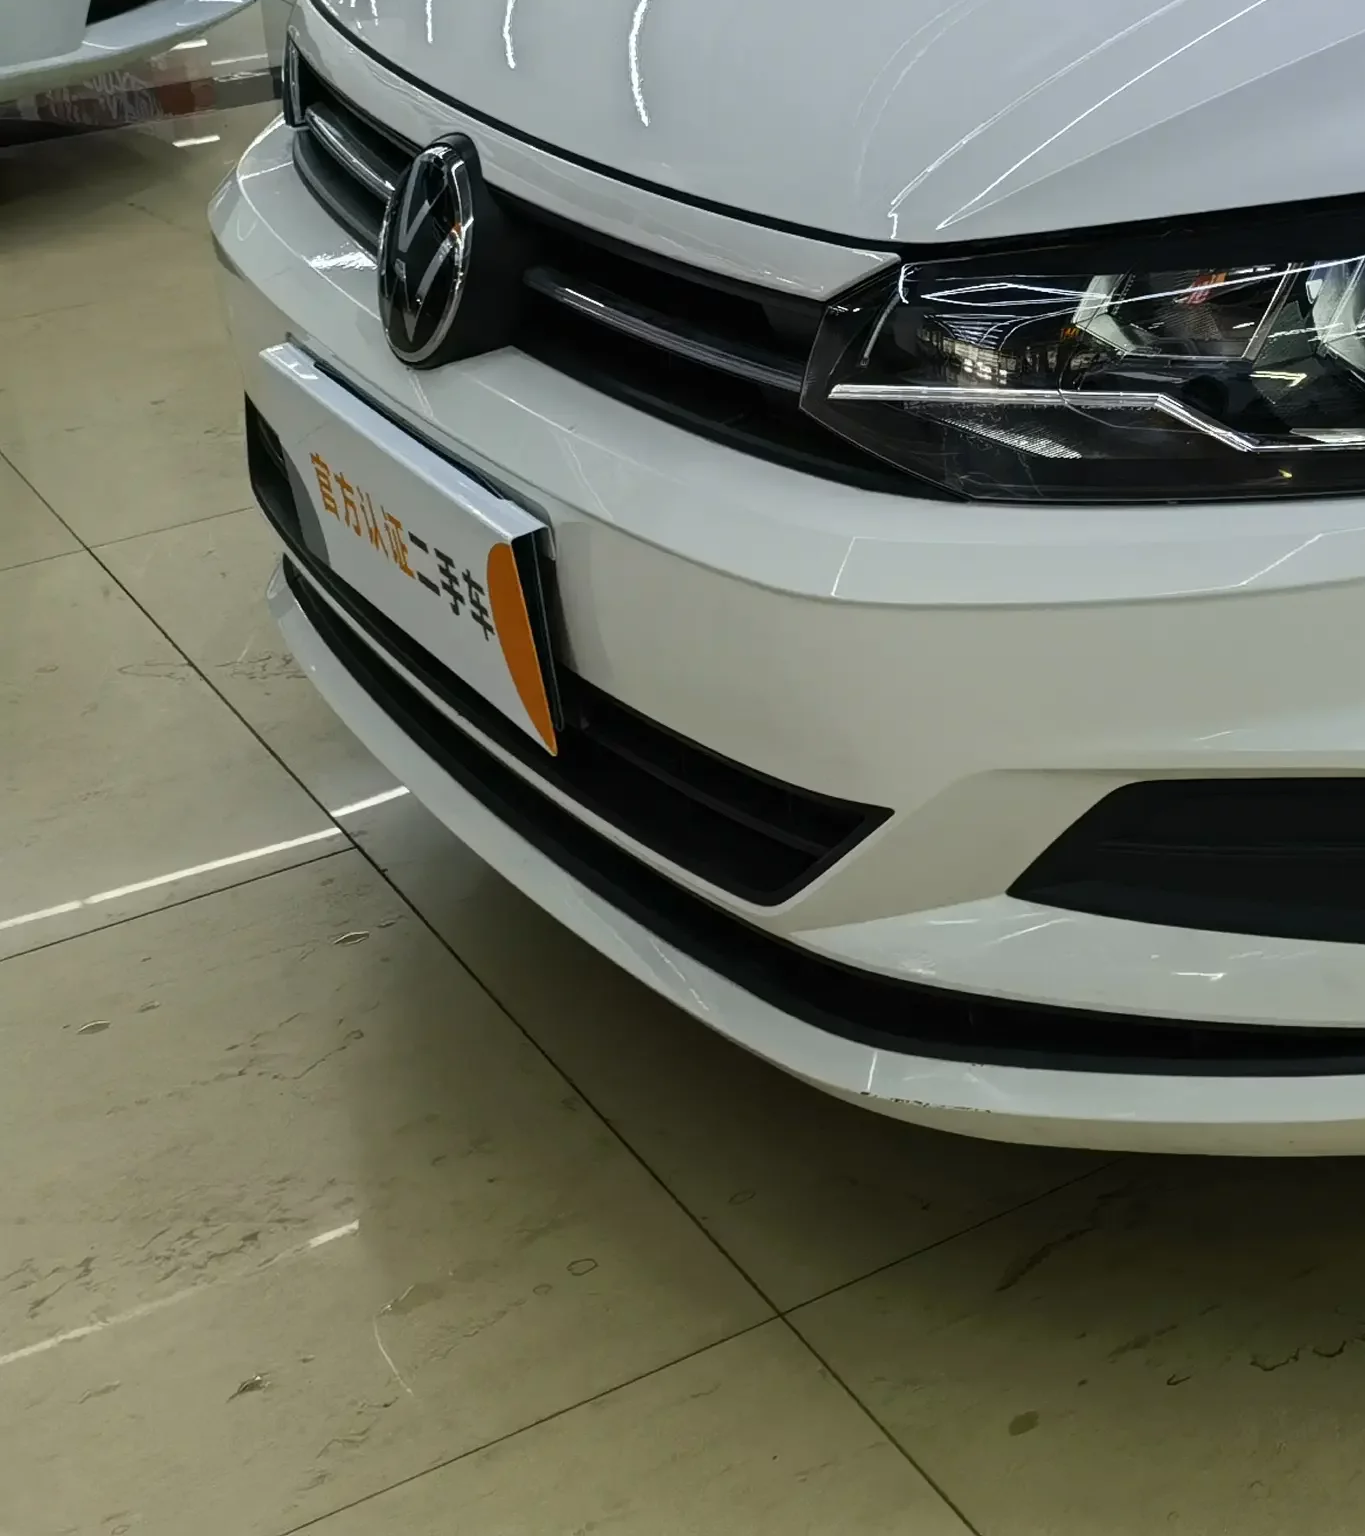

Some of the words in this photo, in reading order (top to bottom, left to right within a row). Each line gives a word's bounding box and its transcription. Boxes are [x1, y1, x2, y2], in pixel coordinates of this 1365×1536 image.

[309, 452, 496, 642] 官方认证二手车
